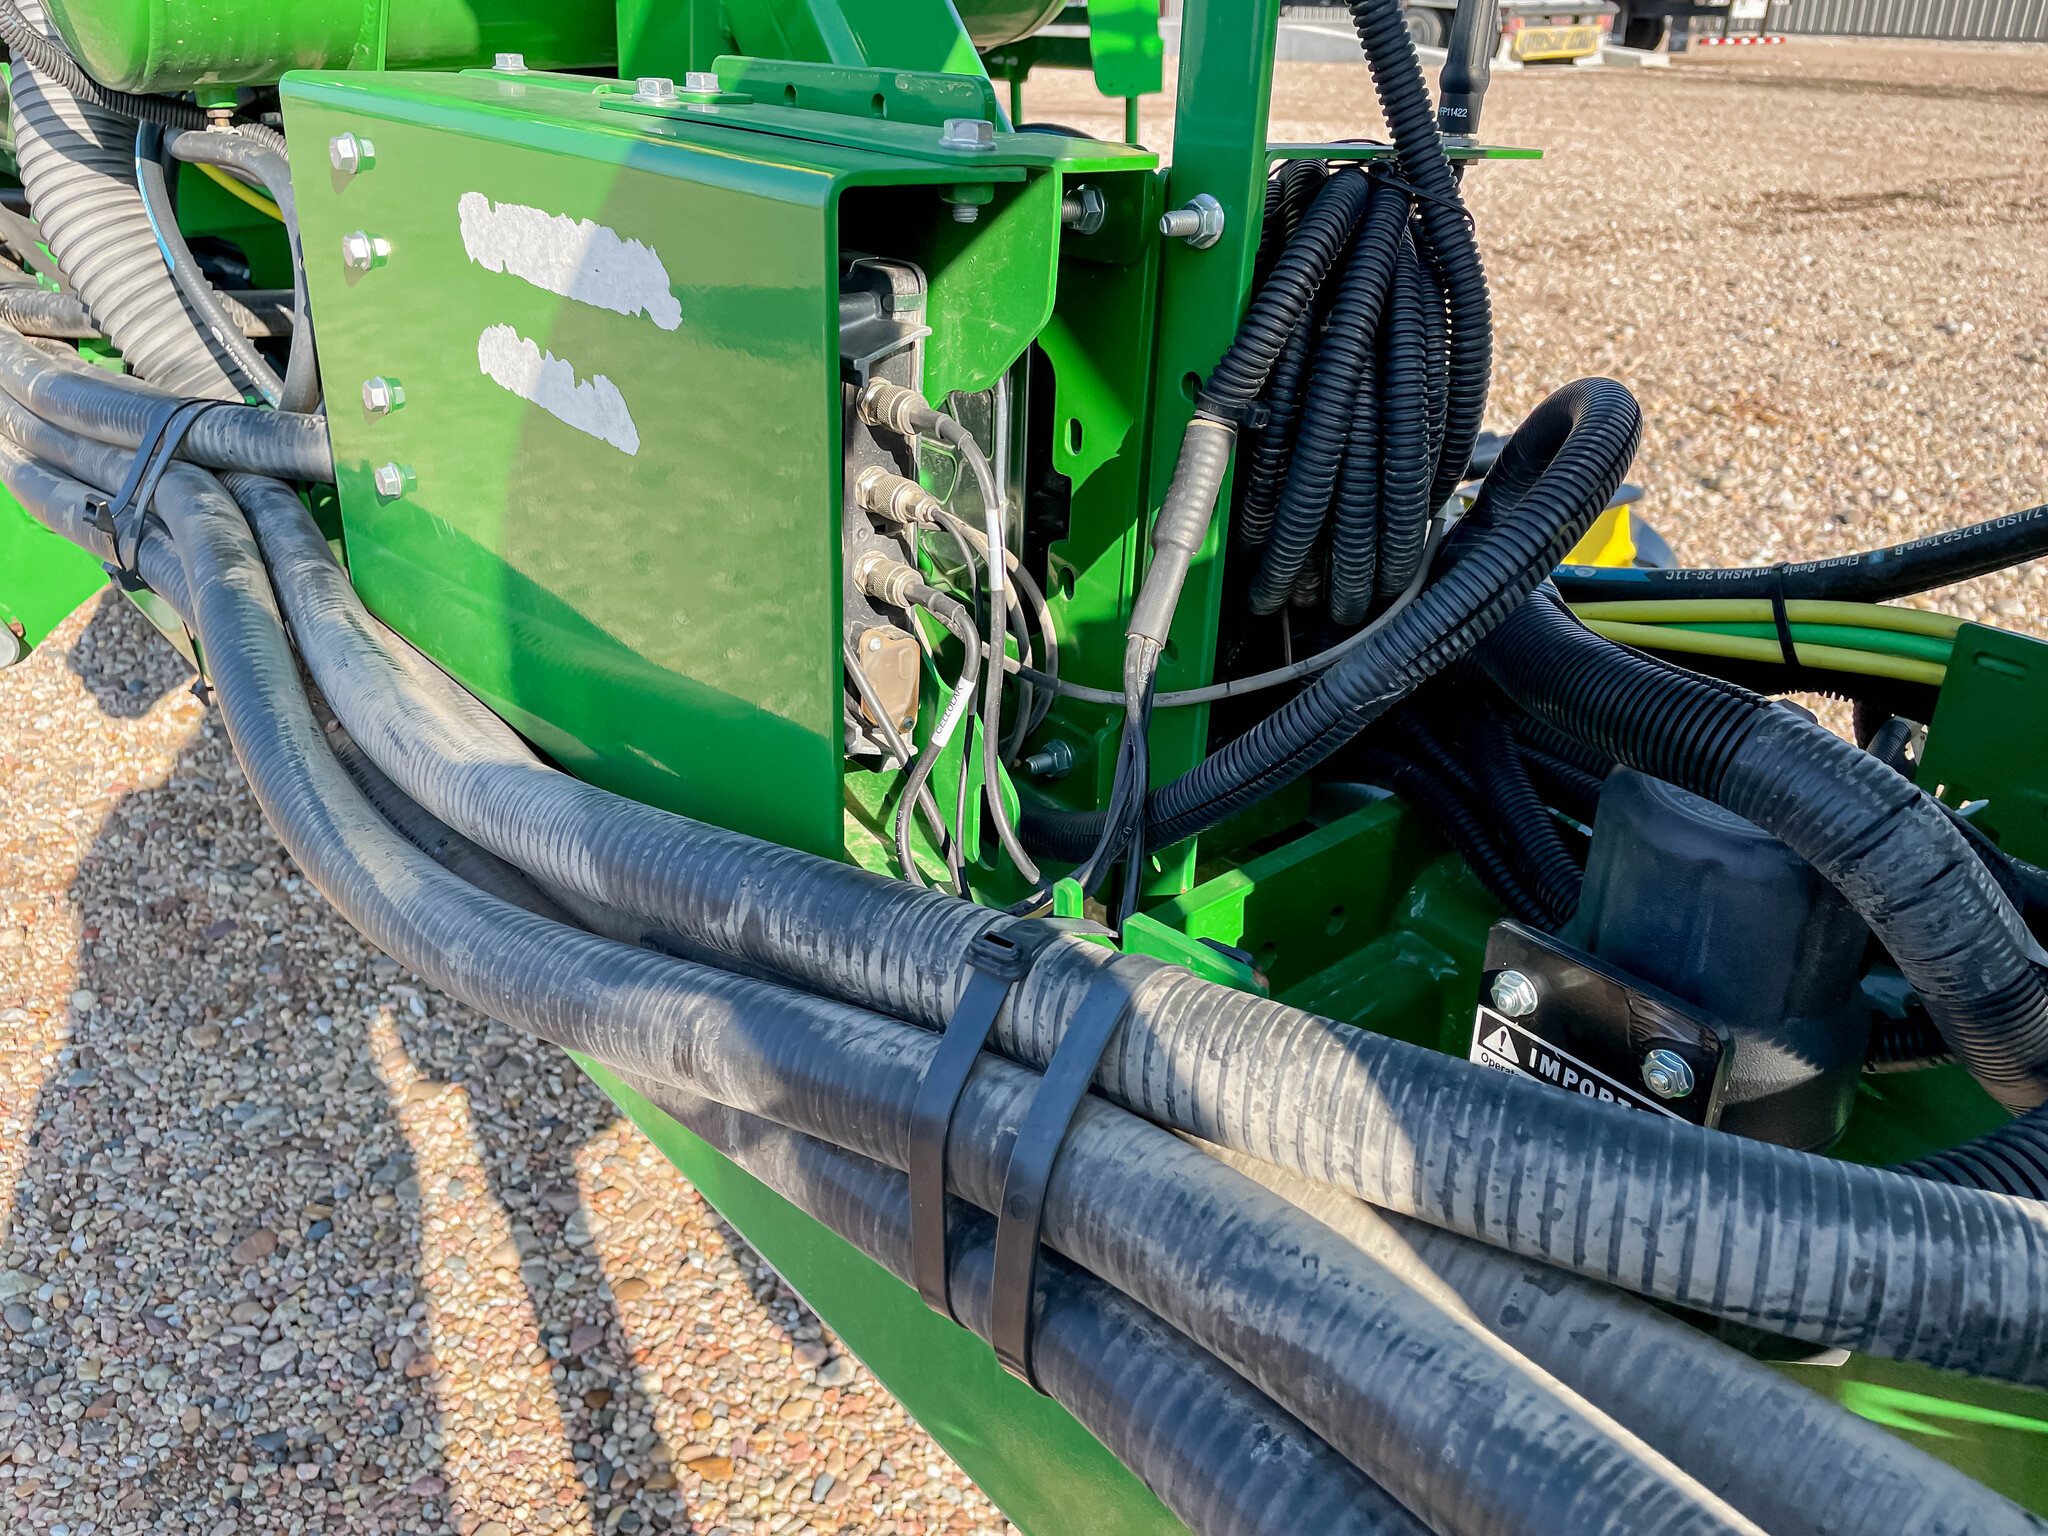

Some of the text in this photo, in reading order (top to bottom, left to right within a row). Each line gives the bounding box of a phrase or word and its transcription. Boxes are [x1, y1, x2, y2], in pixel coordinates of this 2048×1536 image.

[1943, 522, 1992, 544] 18752
[1894, 546, 1904, 556] B
[1907, 538, 1940, 550] Type
[1819, 554, 1861, 570] Flame
[1717, 569, 1752, 580] MSHA
[935, 684, 963, 736] CELLULAR
